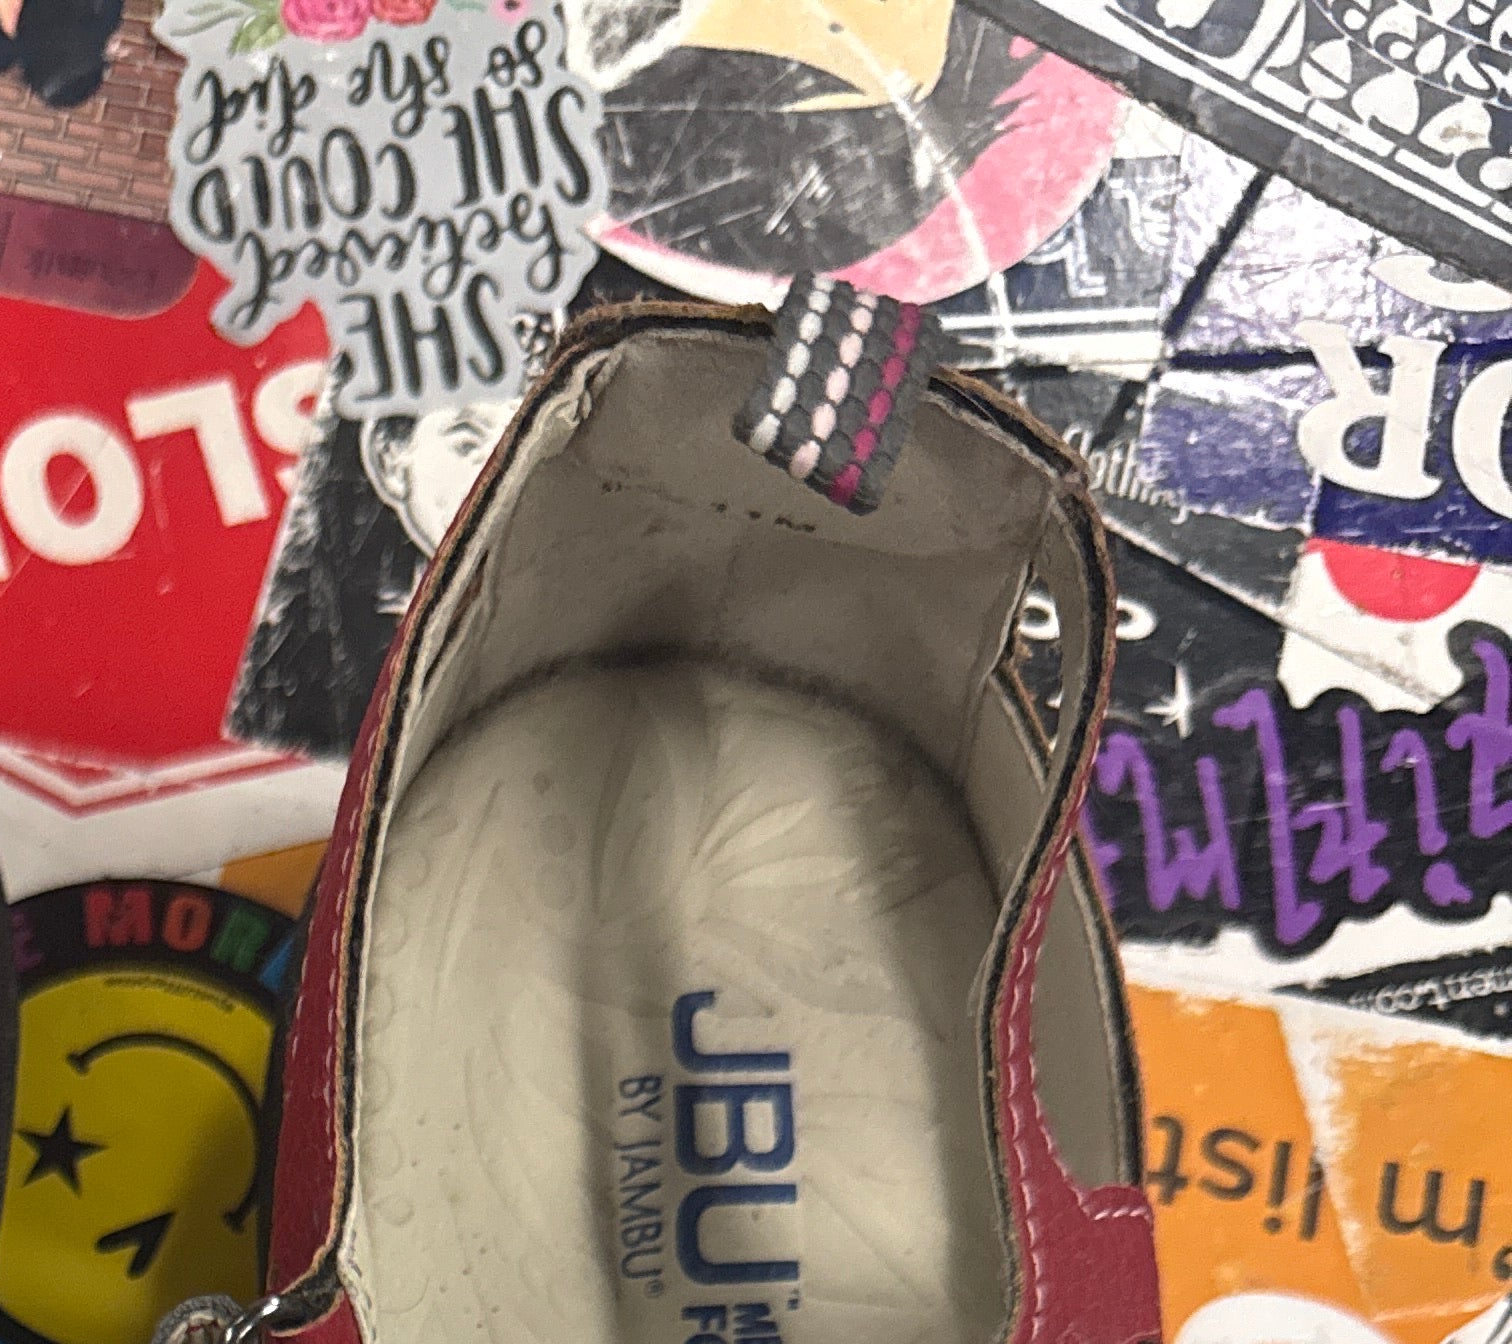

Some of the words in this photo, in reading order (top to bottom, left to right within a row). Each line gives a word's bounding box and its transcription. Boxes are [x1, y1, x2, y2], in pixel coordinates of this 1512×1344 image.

[187, 55, 320, 164] did
[348, 36, 452, 140] she
[485, 20, 548, 89] so
[188, 128, 418, 246] COULD
[444, 87, 591, 208] SHE
[224, 193, 567, 332] believed
[338, 274, 507, 402] SHE
[618, 1074, 663, 1118] BY
[1148, 1116, 1325, 1242] list
